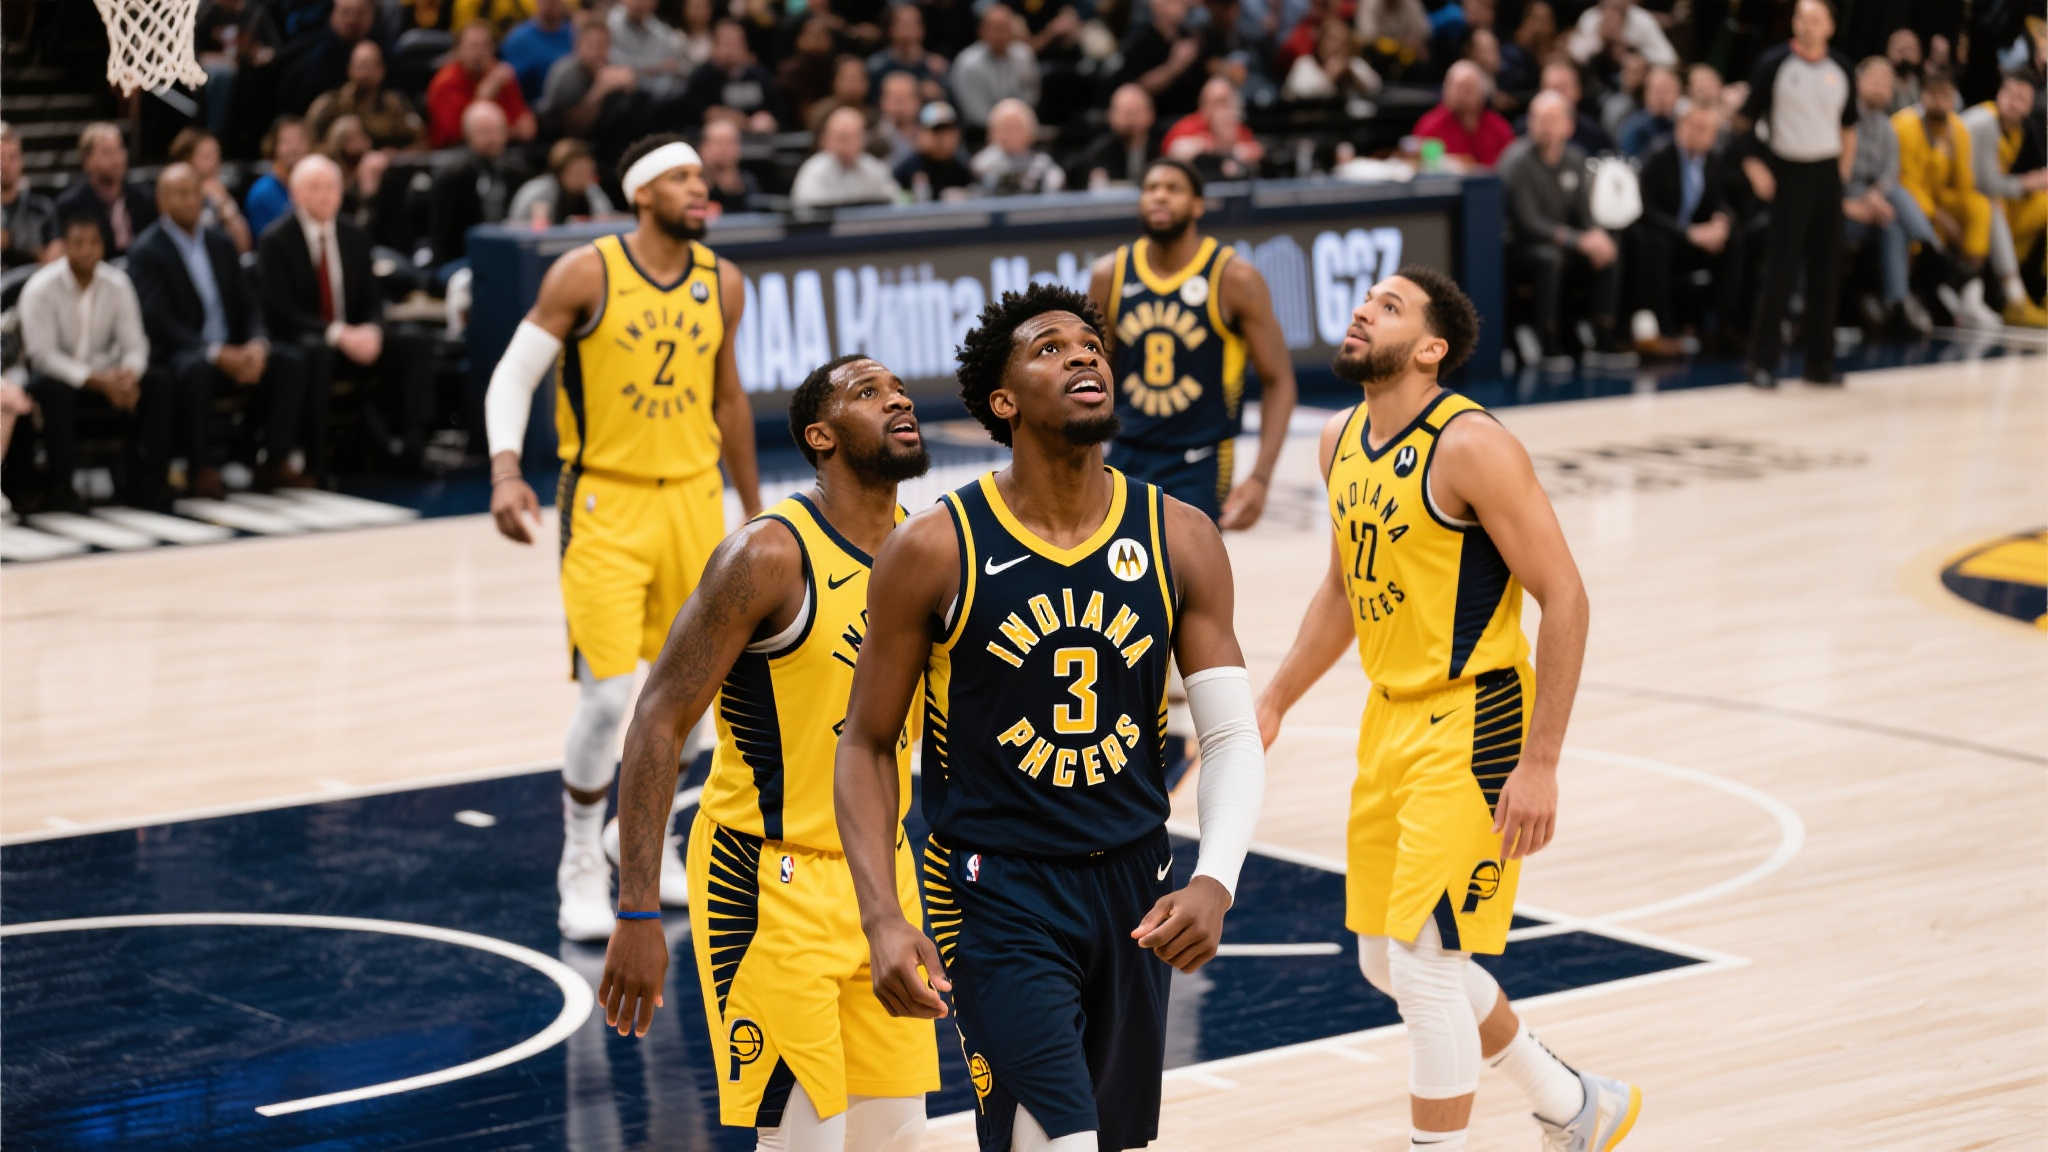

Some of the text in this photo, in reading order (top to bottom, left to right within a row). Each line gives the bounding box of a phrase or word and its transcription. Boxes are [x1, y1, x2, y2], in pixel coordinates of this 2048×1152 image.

[615, 307, 711, 354] INDIANA
[1144, 332, 1175, 387] 8
[654, 341, 676, 386] 2
[1331, 478, 1410, 543] INDIANA
[986, 587, 1154, 669] INDIANA
[1053, 646, 1098, 735] 3
